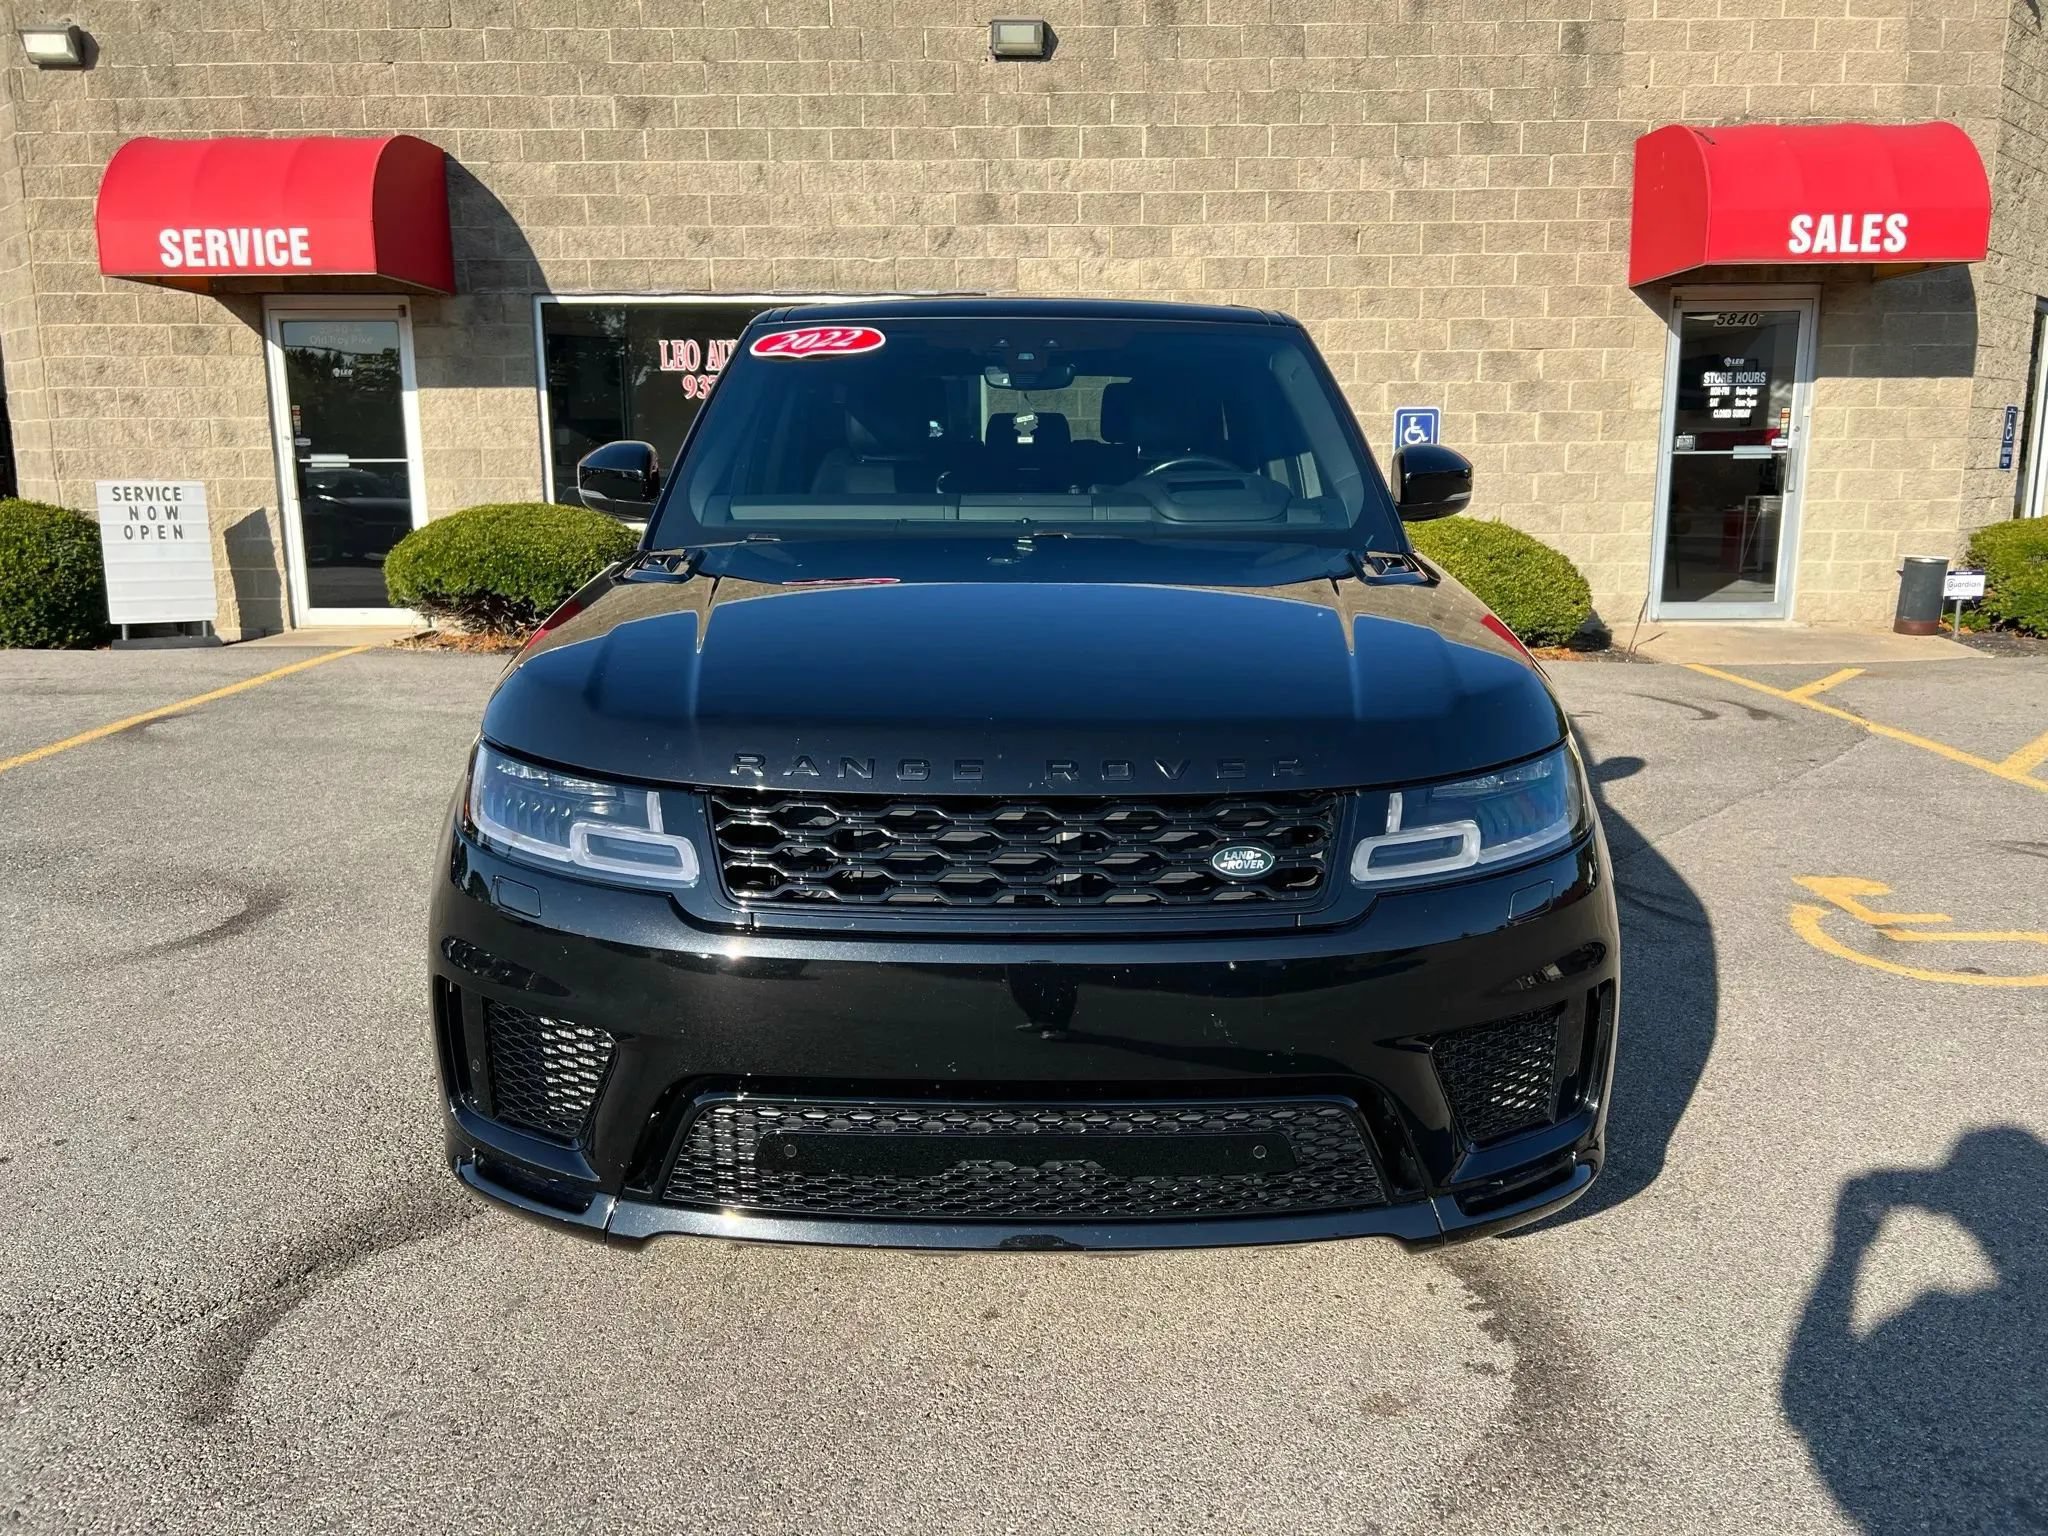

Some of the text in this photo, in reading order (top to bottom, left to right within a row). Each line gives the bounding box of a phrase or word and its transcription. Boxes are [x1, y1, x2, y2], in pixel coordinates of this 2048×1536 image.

[1788, 213, 1908, 253] SALES
[159, 228, 312, 267] SERVICE
[1716, 313, 1760, 326] 5840
[767, 329, 864, 351] 2022
[658, 339, 701, 372] LEO
[1703, 371, 1766, 383] STORE HOURS
[112, 486, 182, 502] SERVICE
[128, 505, 179, 521] NOW
[123, 524, 184, 540] OPEN
[1947, 579, 1981, 591] Guardian
[730, 753, 1304, 782] RANGE ROVER
[1224, 850, 1256, 861] LAND
[1226, 860, 1265, 870] ROVER
